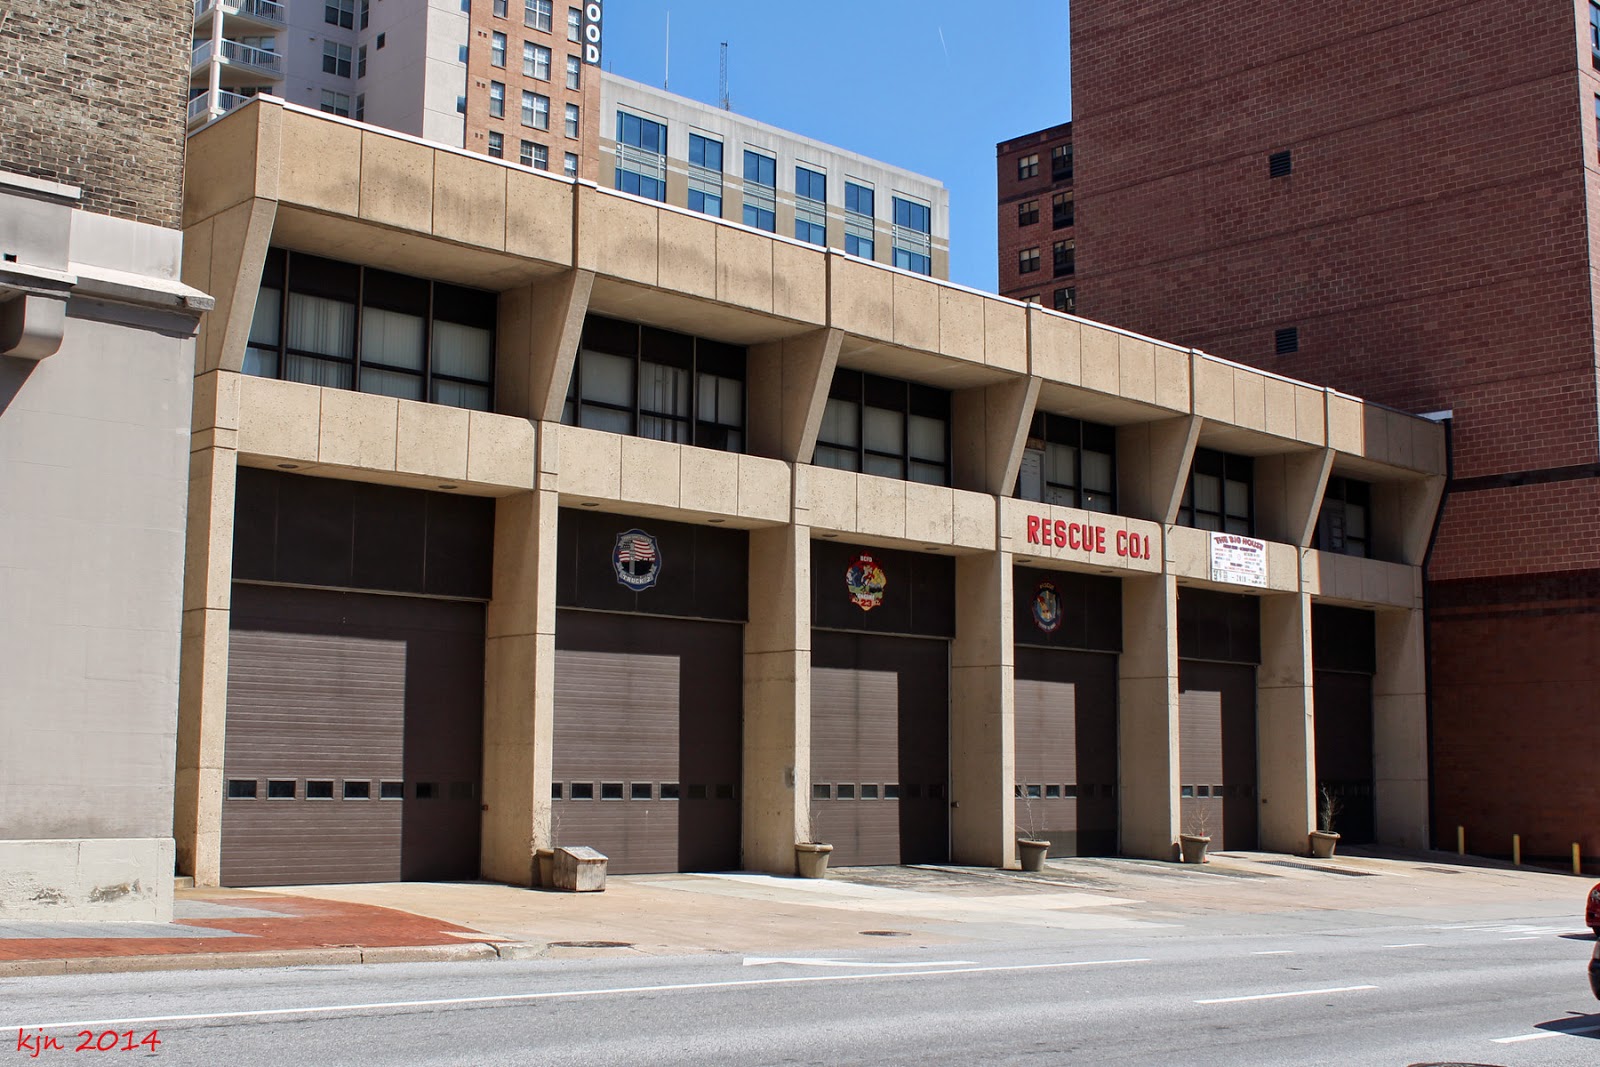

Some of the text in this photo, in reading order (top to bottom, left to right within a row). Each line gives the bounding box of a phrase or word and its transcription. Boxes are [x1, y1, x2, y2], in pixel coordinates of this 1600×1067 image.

[586, 0, 601, 63] OOD
[1027, 515, 1106, 554] RESCUE
[1214, 536, 1228, 544] THE
[1229, 536, 1241, 544] BIG
[622, 574, 644, 584] TRUCK
[860, 599, 873, 607] 23
